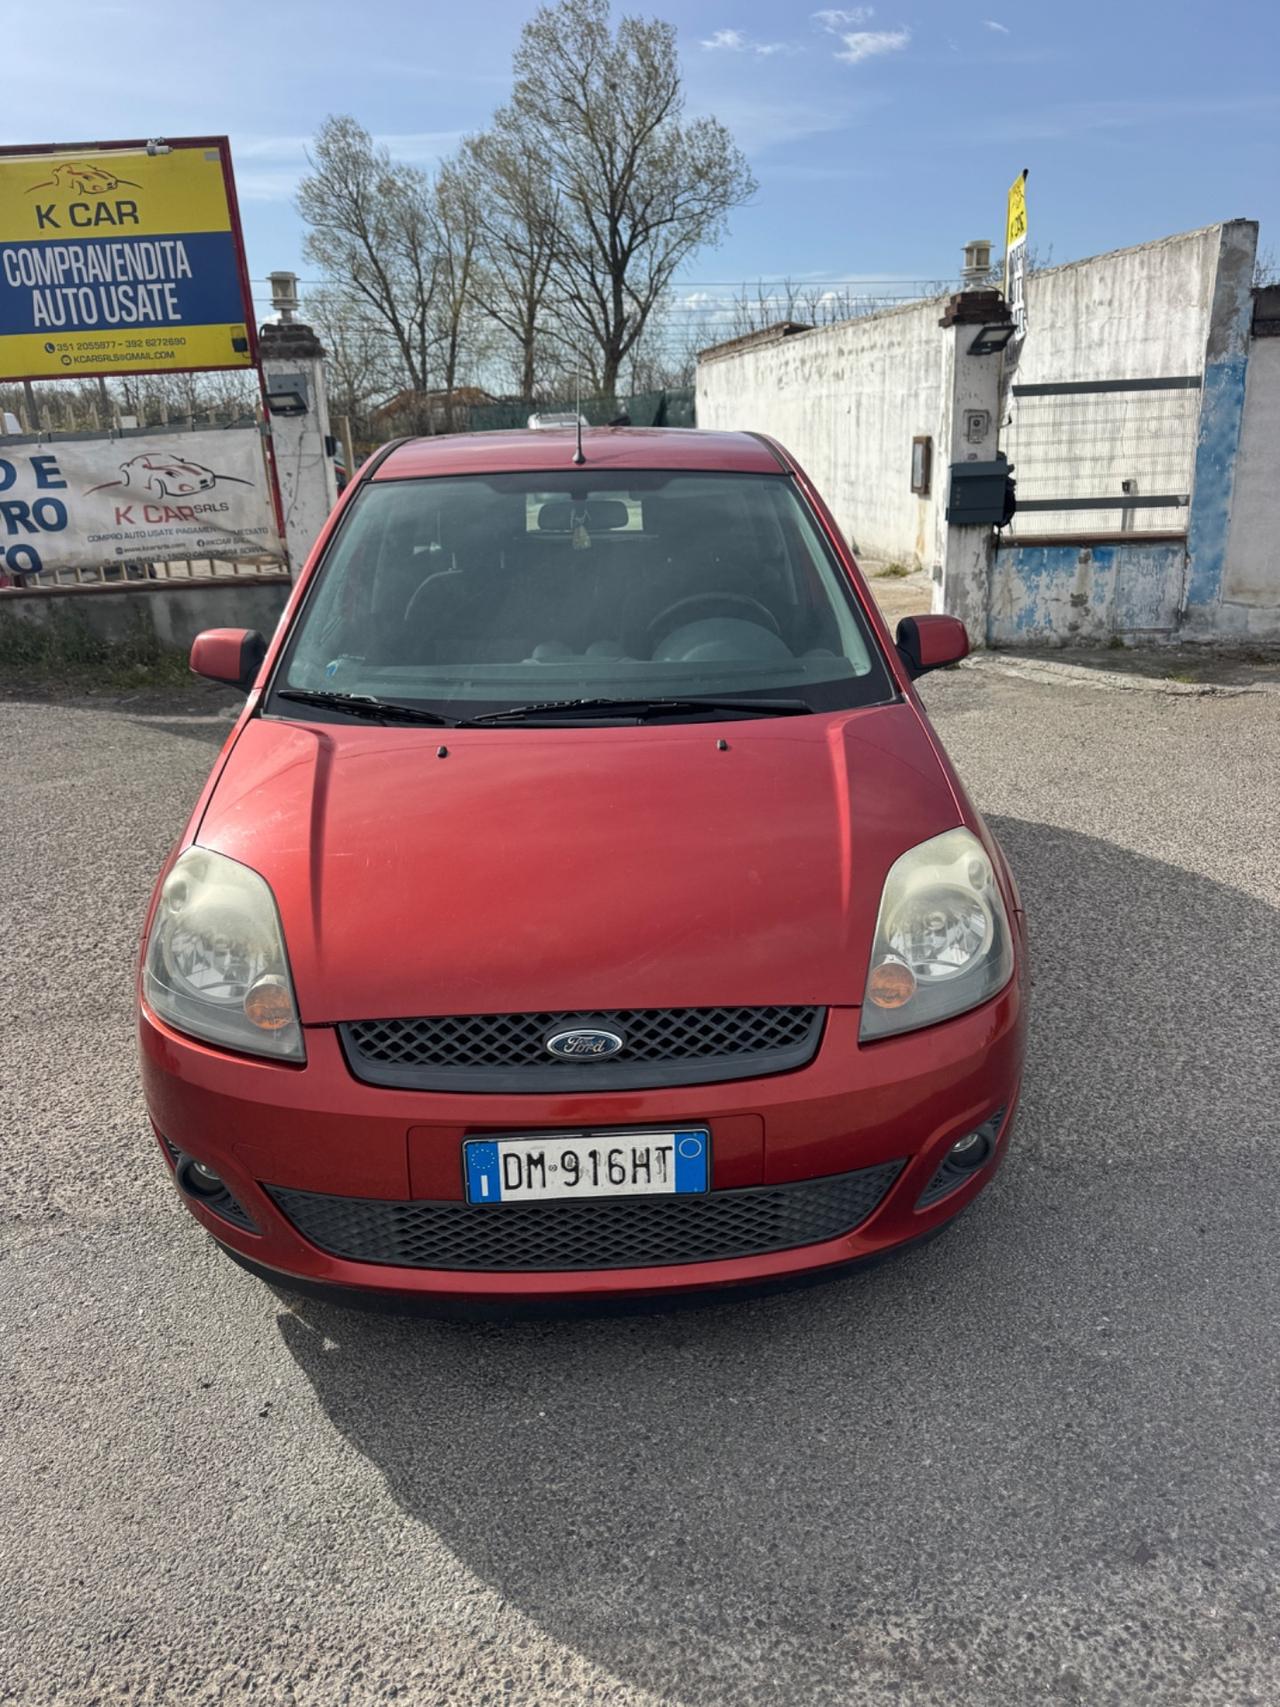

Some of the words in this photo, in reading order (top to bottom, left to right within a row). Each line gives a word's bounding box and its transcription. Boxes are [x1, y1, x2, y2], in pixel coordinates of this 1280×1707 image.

[35, 204, 61, 229] K
[68, 200, 140, 228] CAR
[2, 240, 193, 288] COMPRAVENDITA
[32, 287, 98, 327] AUTO
[101, 283, 182, 324] USATE
[56, 343, 74, 352] 351
[29, 455, 67, 489] E
[115, 505, 136, 525] K
[143, 504, 199, 524] CAR
[195, 502, 230, 514] SRLS
[87, 532, 123, 543] COMPRO
[124, 530, 146, 540] AUTO
[147, 527, 173, 538] USATE
[563, 1036, 606, 1053] Ford
[503, 1151, 547, 1190] DM
[560, 1146, 673, 1187] 916HT
